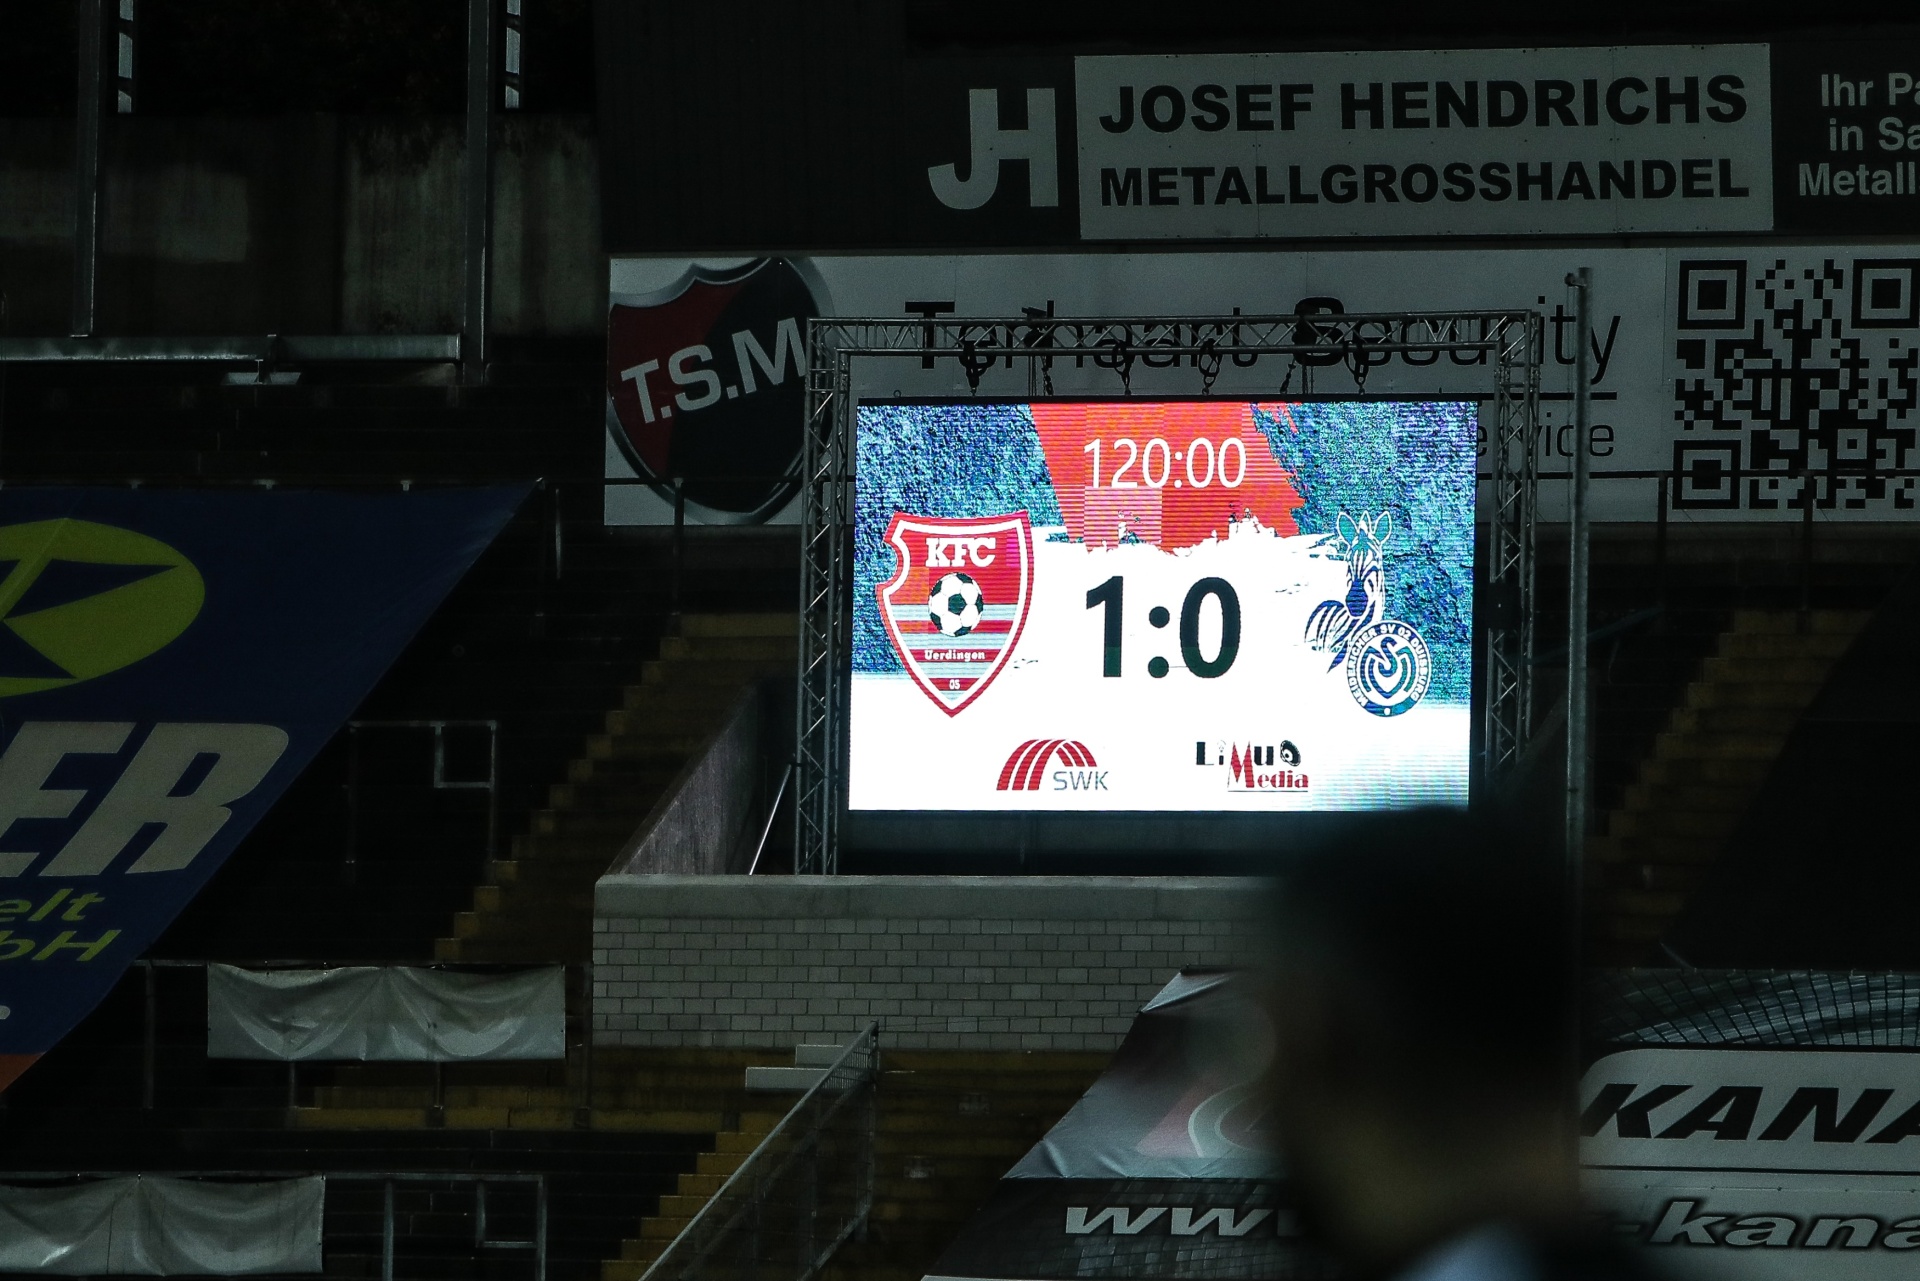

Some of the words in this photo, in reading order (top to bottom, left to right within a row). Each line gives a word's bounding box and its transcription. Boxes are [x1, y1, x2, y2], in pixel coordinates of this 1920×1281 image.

[1100, 83, 1314, 134] JOSEF
[1341, 74, 1747, 130] HENDRICHS
[1821, 73, 1874, 107] Ihr
[1888, 72, 1920, 106] P
[927, 87, 1059, 210] JH
[1829, 117, 1864, 151] in
[1101, 158, 1749, 207] METALLGROSSHANDEL
[1798, 161, 1920, 196] Metall
[1083, 437, 1247, 489] 120:00
[925, 537, 996, 567] KFC
[1086, 575, 1241, 679] 1:0
[1379, 623, 1396, 634] SV
[1397, 627, 1411, 639] 02
[949, 679, 960, 690] 05
[1053, 771, 1109, 790] SWK
[1227, 740, 1309, 789] Media
[0, 721, 289, 877] ER
